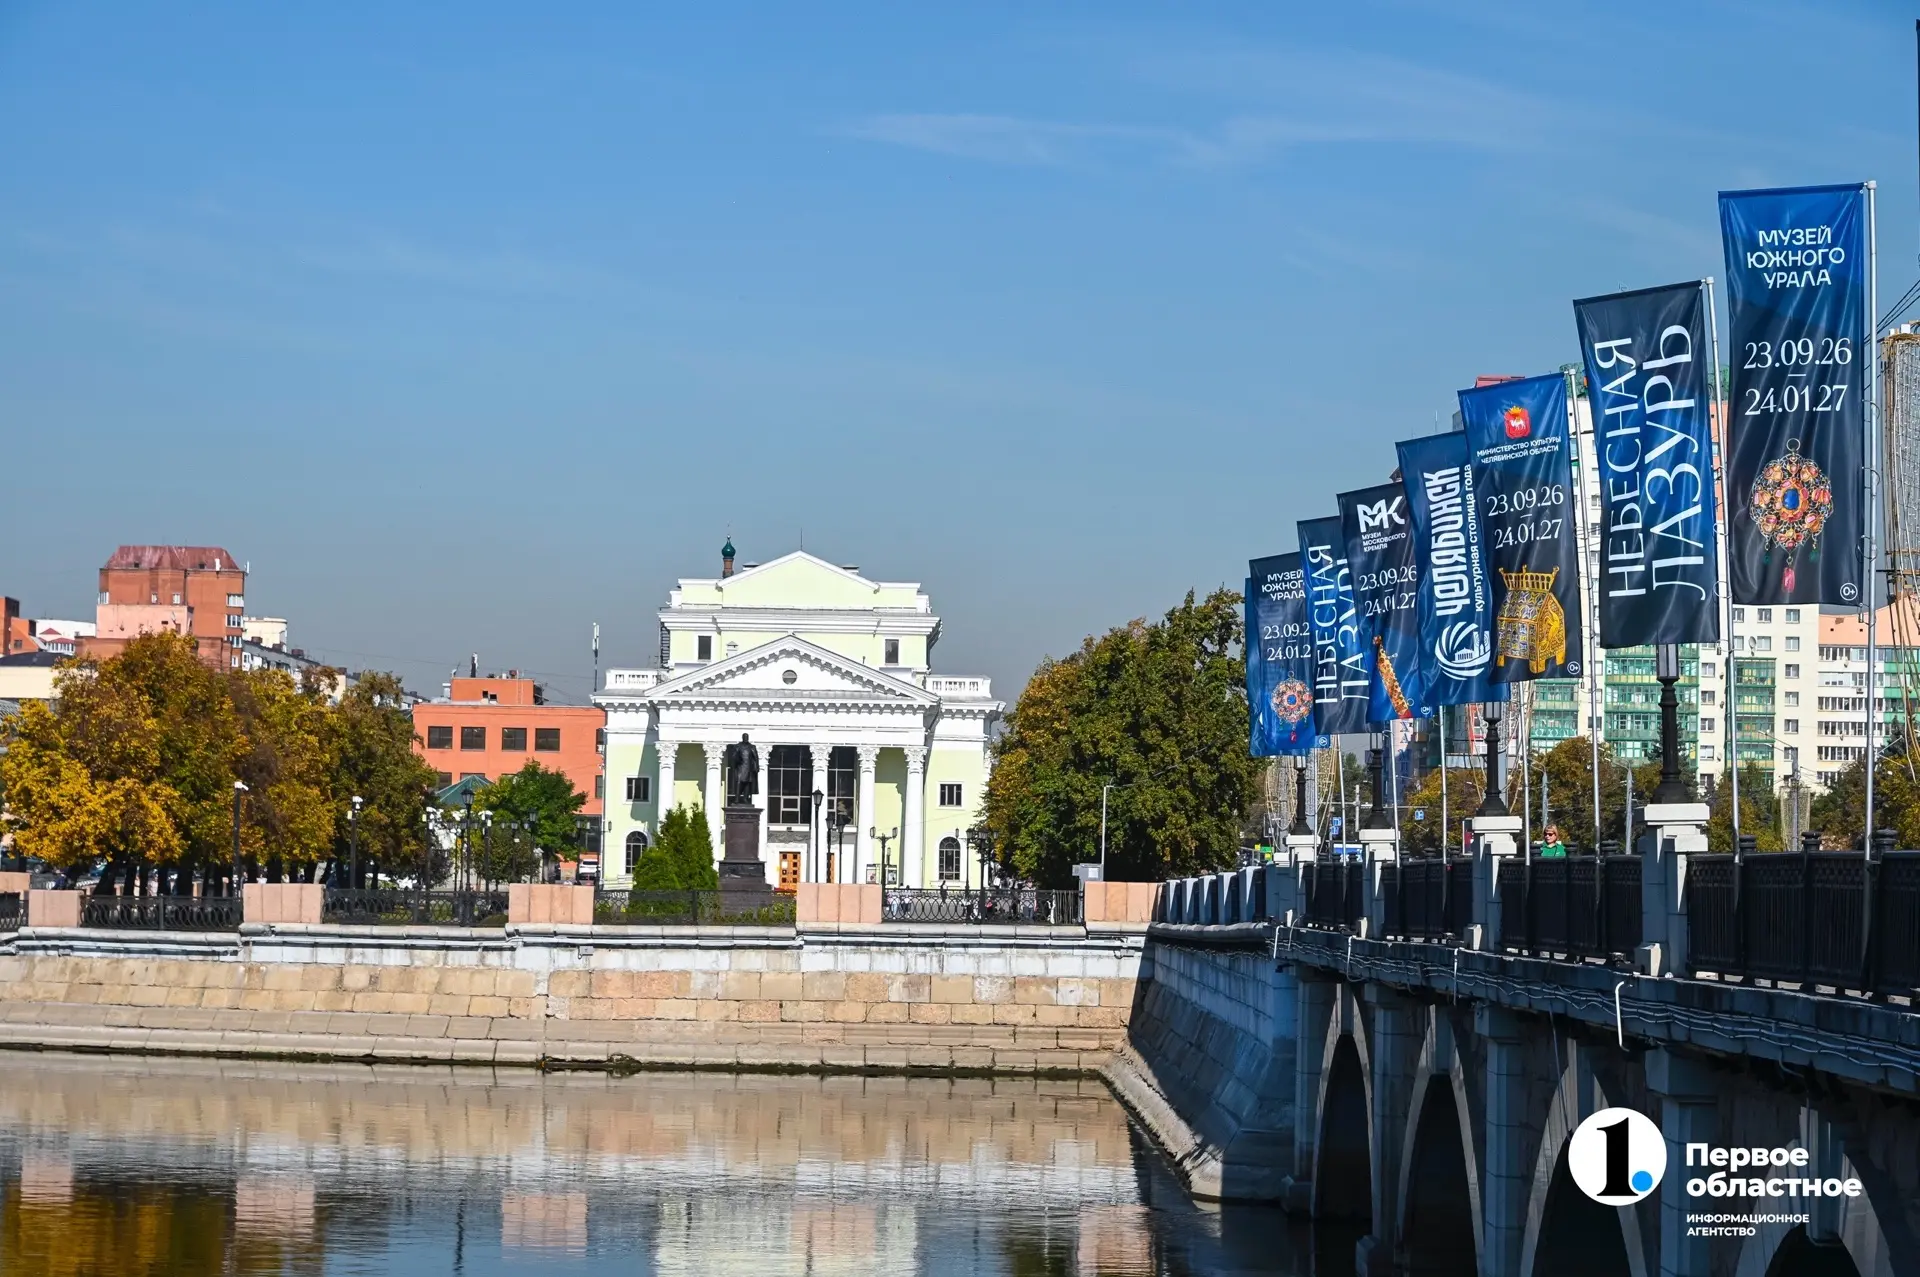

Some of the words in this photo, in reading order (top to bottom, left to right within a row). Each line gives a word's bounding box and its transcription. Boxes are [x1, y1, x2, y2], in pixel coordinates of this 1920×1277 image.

[1758, 225, 1832, 247] МУЗЕЙ
[1746, 247, 1845, 269] ЮЖНОГО
[1763, 268, 1832, 289] УРАЛА
[1743, 337, 1852, 369] 23.09.26
[1744, 384, 1849, 416] 24.01.27
[1476, 441, 1530, 457] МИНИСТЕРСТВО
[1530, 436, 1562, 448] КУЛЬТУРЫ
[1480, 449, 1529, 464] ЧЕЛЯБИНСКОЙ
[1529, 445, 1559, 456] ОБЛАСТИ
[1594, 337, 1646, 598] НЕБЕСНАЯ
[1642, 324, 1706, 601] ЛАЗУРЬ
[1463, 463, 1474, 491] года
[1486, 484, 1564, 517] 23.09.26
[1465, 490, 1478, 543] столица
[1362, 532, 1407, 547] МОСКОВСКОГО
[1494, 518, 1563, 549] 24.01.27
[1363, 543, 1388, 553] КРЕМЛЯ
[1261, 580, 1305, 593] ЮЖНОГ
[1267, 569, 1304, 583] МУЗЕЙ
[1358, 565, 1417, 591] 23.09.26
[1469, 545, 1484, 612] культурная
[1270, 590, 1306, 602] УРАЛА
[1364, 592, 1417, 617] 24.01.27
[1263, 622, 1310, 640] 23.09.2
[1308, 544, 1338, 703] НЕБЕСНАЯ
[1267, 644, 1312, 661] 24.01.2
